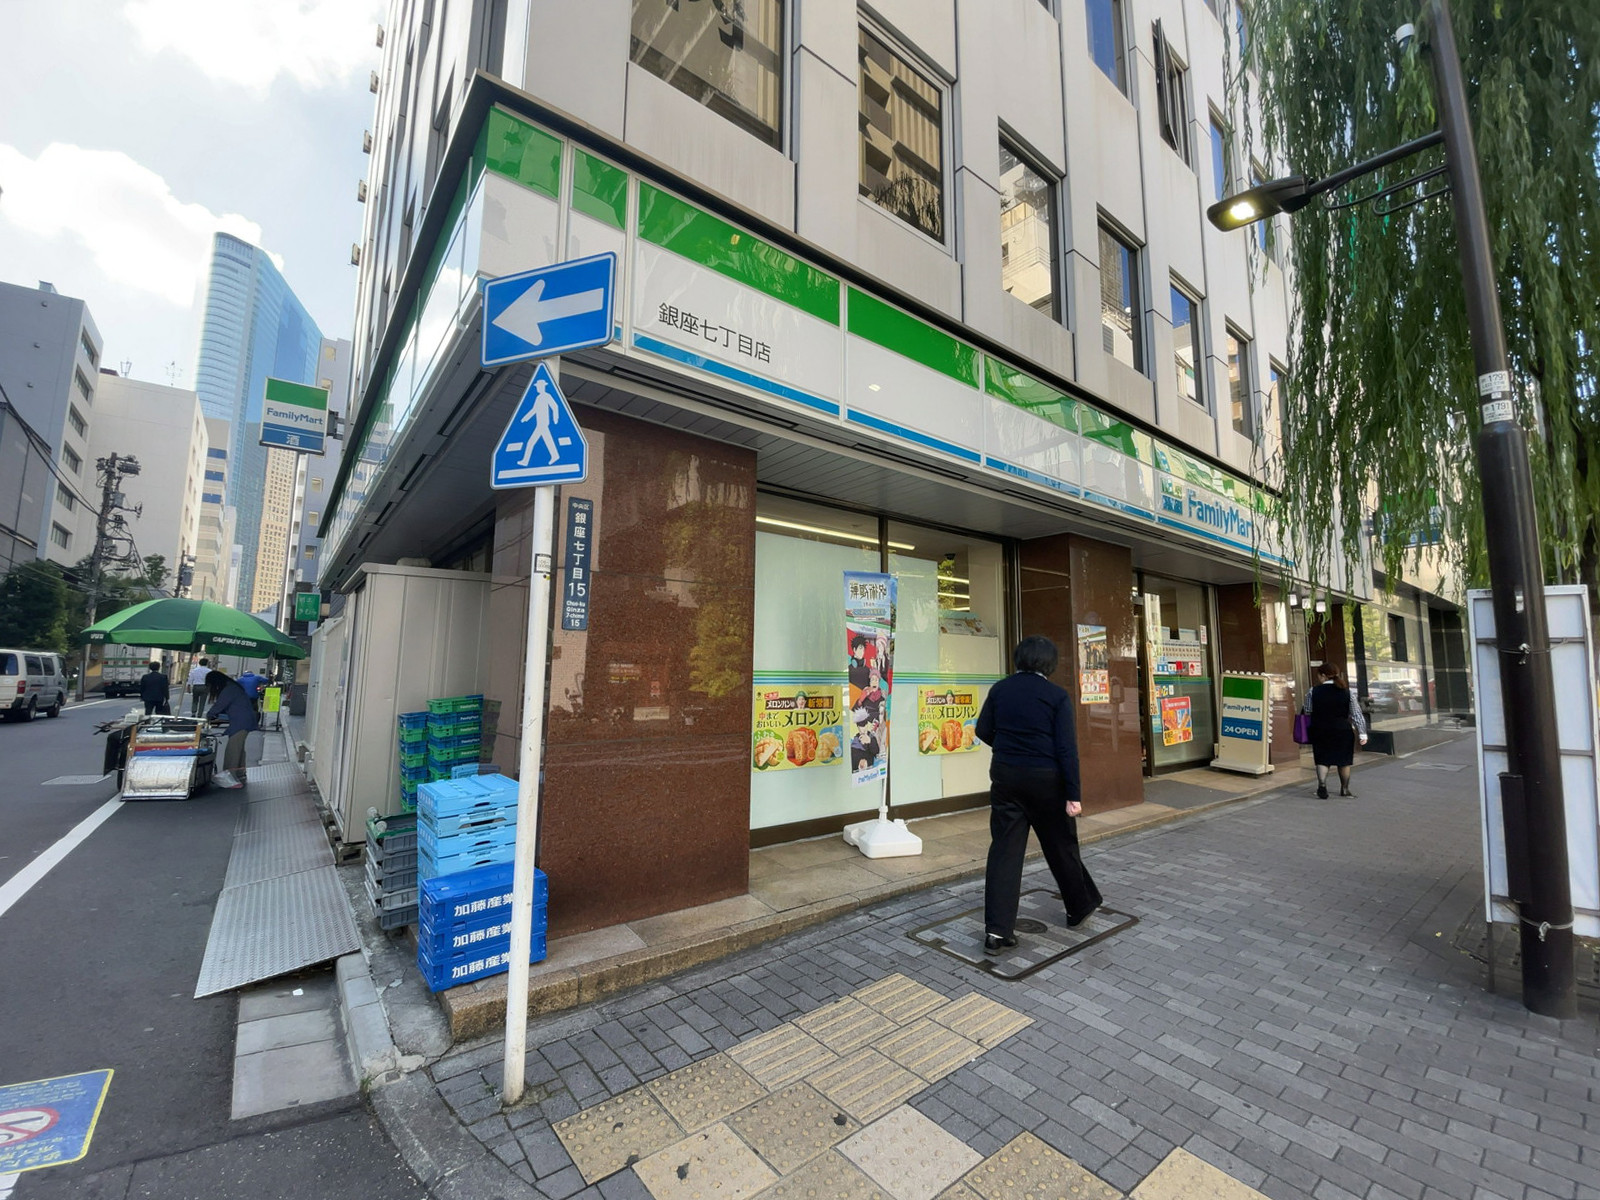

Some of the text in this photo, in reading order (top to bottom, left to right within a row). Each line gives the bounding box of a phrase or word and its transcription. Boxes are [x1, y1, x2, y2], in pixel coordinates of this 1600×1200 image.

[658, 302, 771, 364] 銀座七丁目店
[266, 407, 323, 425] FamilyMart
[1187, 488, 1252, 538] FamilyMar
[572, 512, 587, 580] 銀座七丁目
[568, 582, 586, 597] 15
[938, 706, 978, 719] メロンパン
[1223, 703, 1260, 713] FamilyMart
[782, 711, 840, 727] メロンパン
[1224, 725, 1259, 736] 24 OPEN
